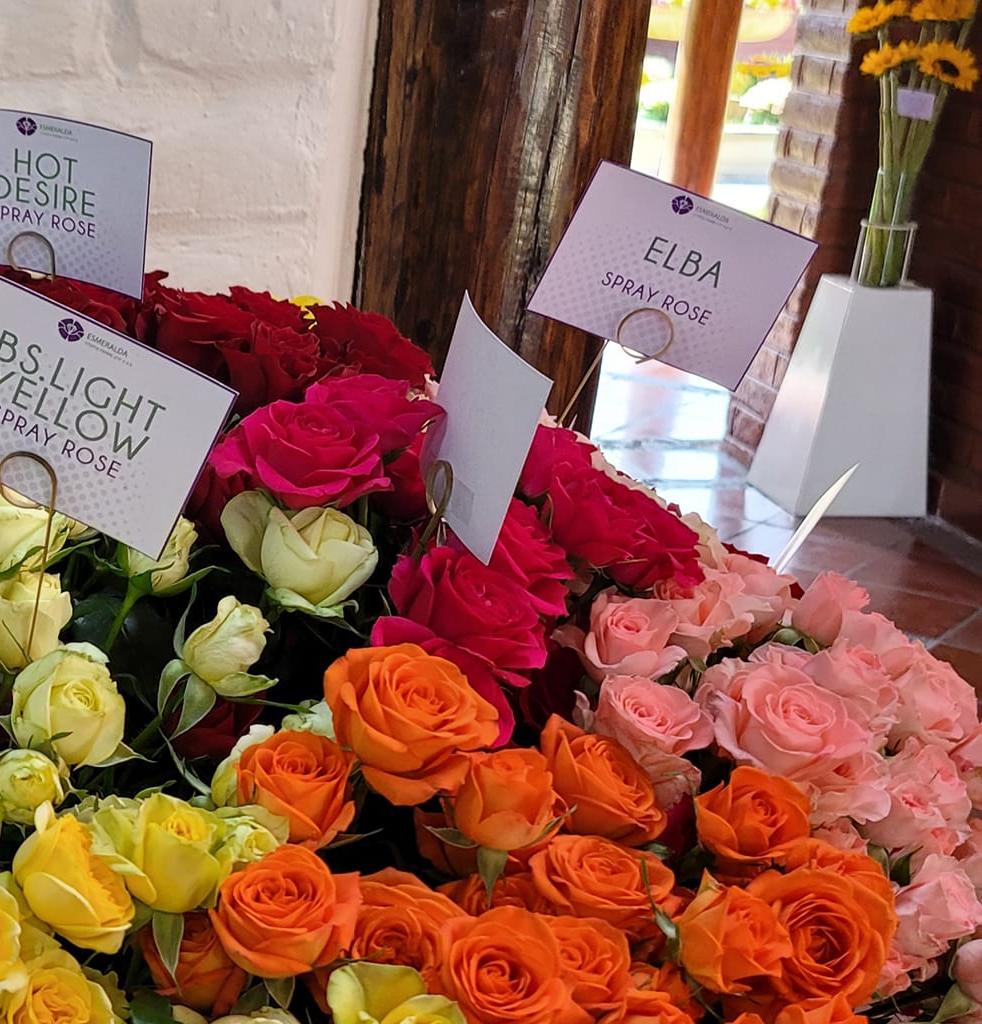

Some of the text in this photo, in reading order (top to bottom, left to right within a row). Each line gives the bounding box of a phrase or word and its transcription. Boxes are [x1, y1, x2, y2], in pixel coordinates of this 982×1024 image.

[14, 148, 78, 183] HOT
[51, 215, 96, 238] ROSE
[643, 236, 722, 288] ELBA
[601, 271, 712, 326] SPRAY ROSE
[86, 332, 129, 358] ESMERALDA
[61, 439, 122, 478] ROSE
